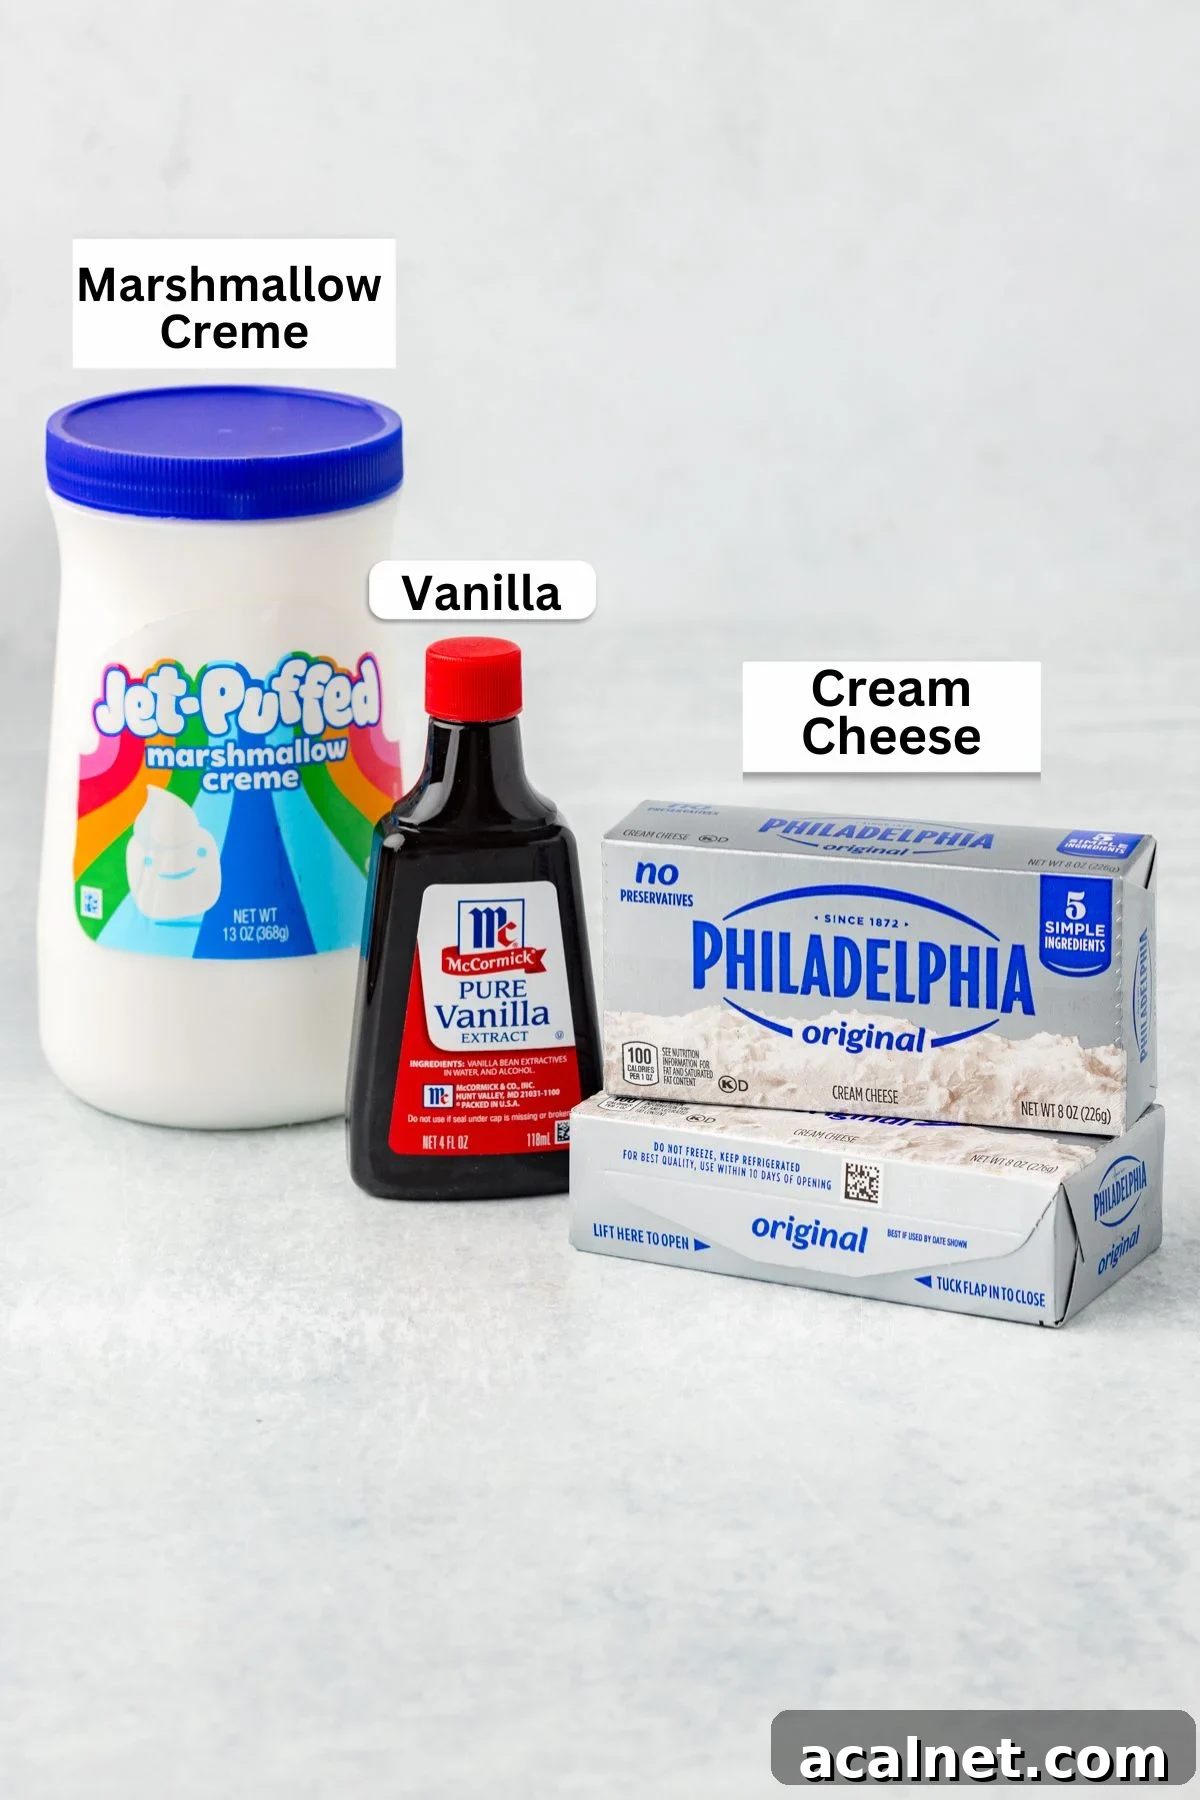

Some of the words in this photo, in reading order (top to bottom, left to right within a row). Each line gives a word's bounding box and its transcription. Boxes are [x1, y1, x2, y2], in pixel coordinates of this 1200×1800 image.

[94, 655, 382, 737] Jet-Puffed
[146, 738, 348, 768] marshmallow
[202, 769, 301, 791] creme
[622, 828, 655, 839] CREAM
[656, 831, 690, 841] CHEESE
[757, 817, 994, 850] PHILADELPHIA
[823, 842, 909, 857] original
[1064, 842, 1125, 854] INGREDIENTS
[1068, 838, 1128, 849] SIMPLE
[635, 860, 680, 886] no
[620, 888, 694, 907] PRESERVATIVES
[1065, 890, 1087, 920] 5
[233, 908, 256, 924] NET
[258, 907, 278, 922] WT
[824, 913, 865, 926] SINCE
[869, 917, 899, 929] 1872
[223, 927, 237, 942] 13
[239, 926, 255, 941] OZ
[256, 925, 290, 943] (368g)
[1045, 920, 1106, 938] SIMPLE
[1044, 936, 1106, 953] INGREDIENTS
[445, 950, 534, 973] McCormick
[692, 919, 1036, 1016] PHILADELPHIA
[459, 979, 528, 1000] PURE
[1139, 927, 1148, 1065] PHILADELPHIA
[433, 1000, 551, 1030] Vanilla
[460, 1030, 529, 1044] EXTRACT
[801, 1021, 926, 1054] original
[409, 1059, 465, 1068] INGREDIENTS:
[467, 1059, 499, 1068] VANILLA
[499, 1058, 520, 1067] BEAN
[521, 1055, 568, 1065] EXTRACTIVES
[627, 1047, 652, 1065] 100
[661, 1047, 672, 1057] SEE
[672, 1048, 700, 1059] NUTRITION
[443, 1069, 452, 1077] IN
[480, 1068, 498, 1076] AND
[498, 1066, 536, 1075] ALCOHOL.
[627, 1064, 655, 1074] CALORIES
[662, 1057, 698, 1068] INFORMATION
[699, 1060, 710, 1069] FOR
[663, 1066, 672, 1075] FAT
[672, 1067, 685, 1077] AND
[684, 1068, 714, 1079] SATURATED
[663, 1075, 673, 1085] FAT
[673, 1076, 696, 1087] CONTENT
[456, 1083, 499, 1092] McCORMICK
[499, 1083, 506, 1091] &
[456, 1093, 477, 1101] HUNT
[506, 1091, 520, 1099] MD
[520, 1089, 561, 1098] 21031-1100
[738, 1080, 749, 1092] D
[832, 1084, 864, 1102] CREAM
[865, 1086, 899, 1105] CHEESE
[461, 1101, 490, 1109] PACKED
[498, 1100, 520, 1108] U.S.A.
[1020, 1101, 1040, 1117] NET
[1040, 1101, 1057, 1118] WT
[1057, 1103, 1065, 1118] 8
[1066, 1103, 1080, 1120] OZ
[1080, 1104, 1112, 1125] (226g)
[407, 1114, 418, 1123] Do
[419, 1114, 431, 1123] not
[432, 1115, 445, 1123] use
[446, 1113, 452, 1123] if
[453, 1113, 467, 1123] seal
[467, 1113, 488, 1123] under
[489, 1113, 502, 1124] cap
[511, 1112, 538, 1121] missing
[422, 1135, 437, 1150] NET
[438, 1135, 446, 1149] 4
[446, 1135, 456, 1149] FL
[457, 1135, 469, 1149] OZ
[527, 1132, 551, 1147] 118mL
[793, 1128, 824, 1139] CREAM
[825, 1133, 860, 1144] CHEESE
[653, 1141, 665, 1152] DO
[667, 1143, 683, 1155] NOT
[685, 1146, 717, 1161] FREEZE,
[720, 1151, 740, 1165] KEEP
[742, 1154, 801, 1173] REFRIGERATED
[970, 1154, 990, 1163] NET
[990, 1156, 1005, 1166] WT
[1013, 1160, 1028, 1169] OZ
[622, 1149, 638, 1161] FOR
[640, 1152, 660, 1164] BEST
[662, 1154, 697, 1171] QUALITY,
[699, 1160, 714, 1172] USE
[717, 1163, 747, 1177] WITHIN
[749, 1168, 759, 1179] 10
[761, 1169, 781, 1182] DAYS
[783, 1172, 794, 1184] OF
[796, 1174, 832, 1191] OPENING
[1093, 1161, 1147, 1222] PHILADELPHIA
[593, 1223, 616, 1239] LIFT
[617, 1226, 644, 1243] HERE
[646, 1230, 661, 1245] TO
[661, 1232, 689, 1250] OPEN
[751, 1215, 869, 1253] original
[887, 1228, 902, 1239] BEST
[902, 1231, 908, 1240] IF
[908, 1231, 923, 1242] USED
[924, 1233, 931, 1243] BY
[932, 1234, 946, 1246] DATE
[947, 1236, 968, 1249] SHOWN
[1097, 1224, 1140, 1275] original
[936, 1275, 962, 1294] TUCK
[963, 1280, 988, 1298] FLAP
[989, 1283, 1000, 1299] IN
[1001, 1286, 1015, 1302] TO
[1015, 1287, 1046, 1308] CLOSE
